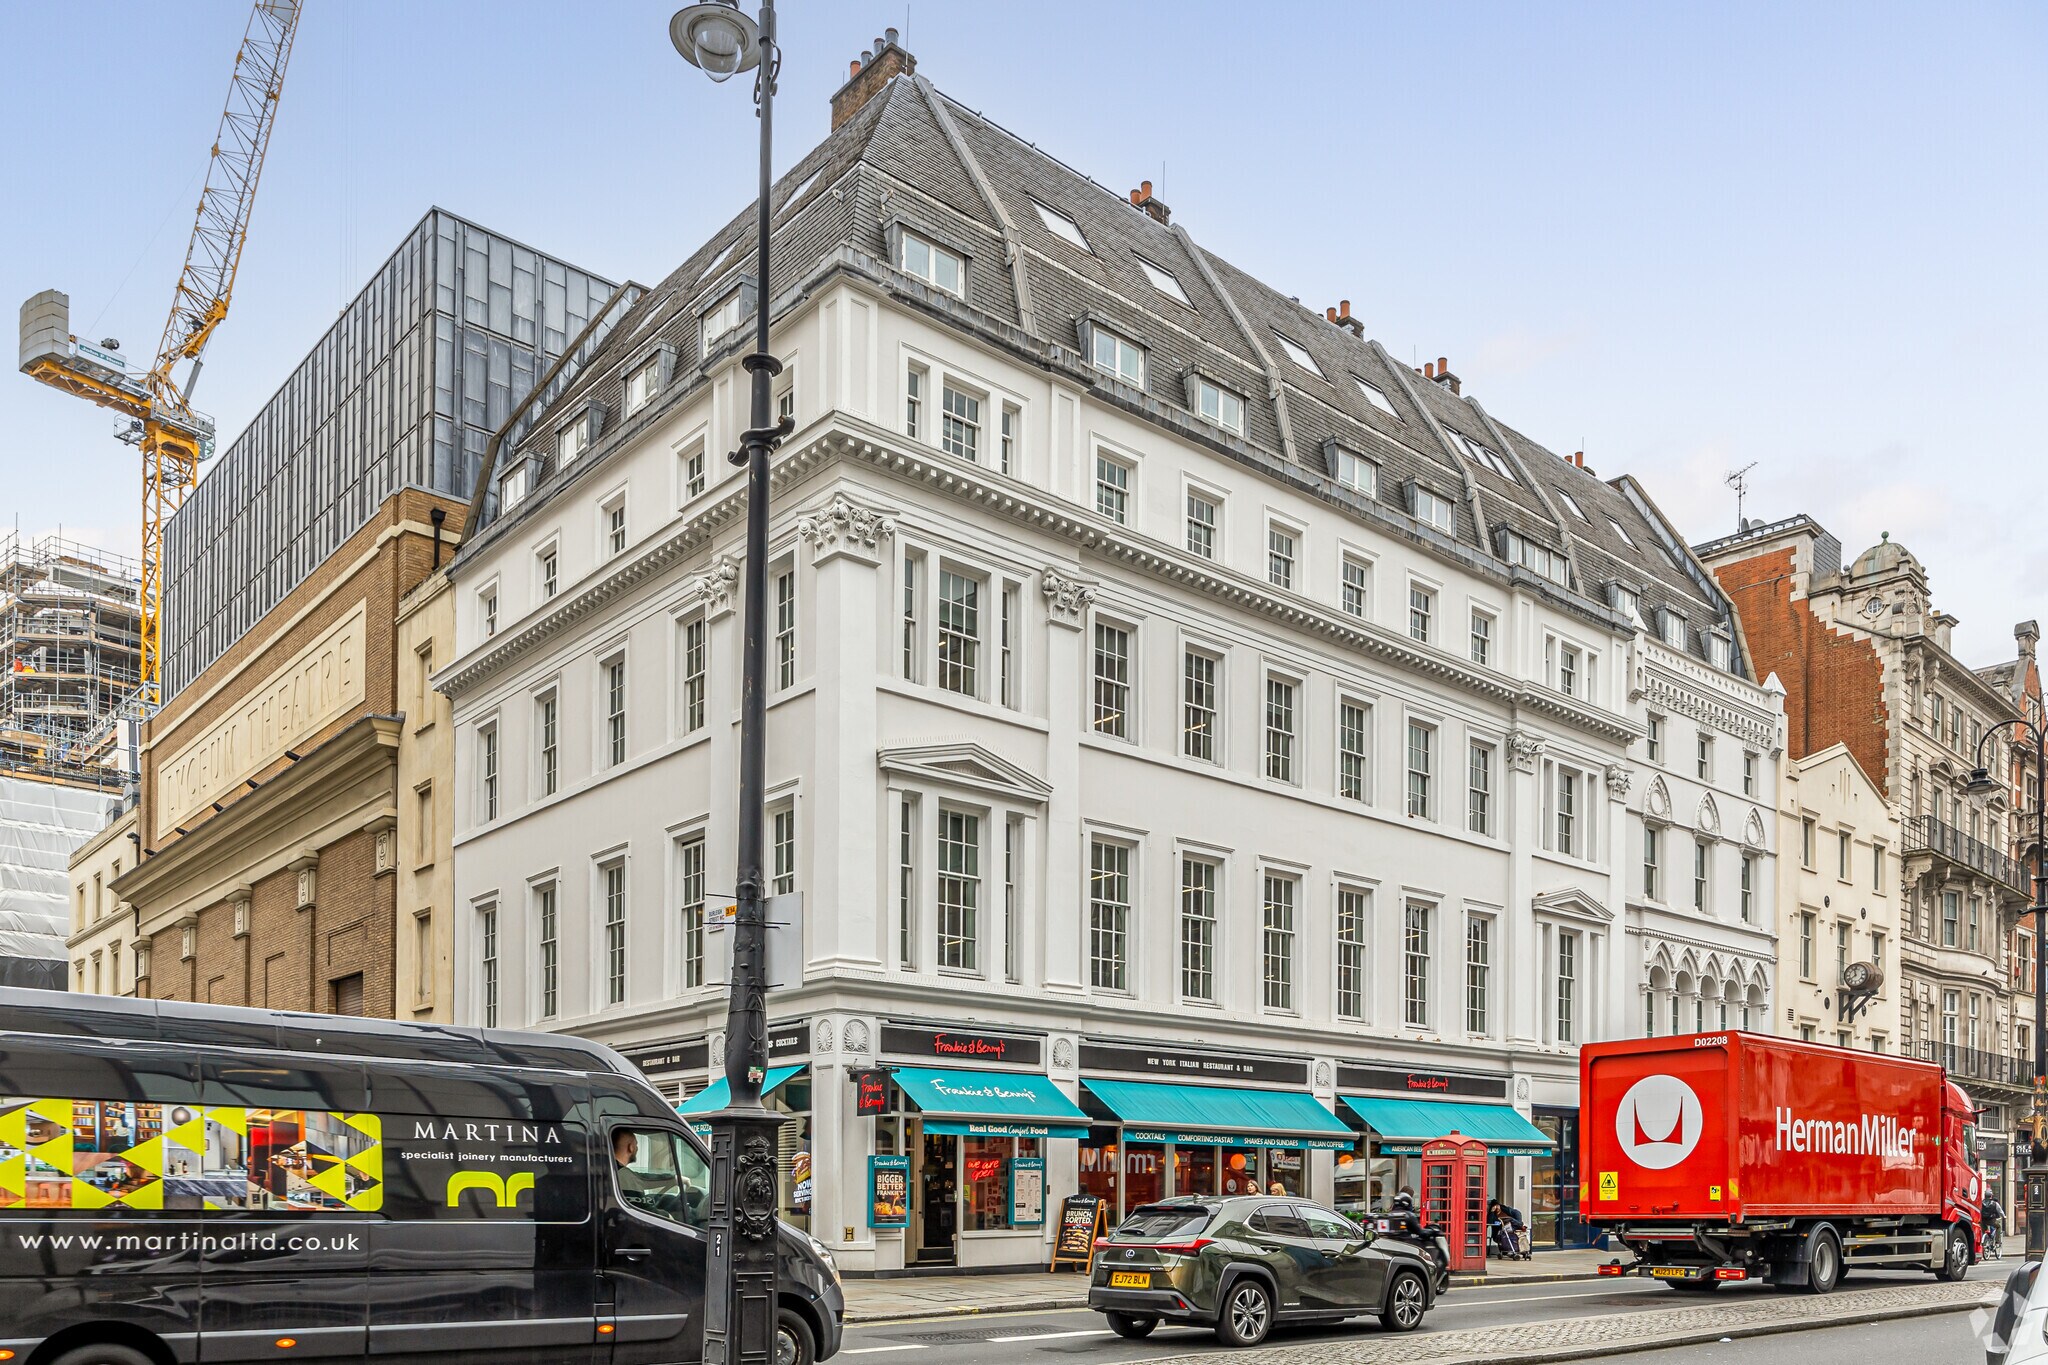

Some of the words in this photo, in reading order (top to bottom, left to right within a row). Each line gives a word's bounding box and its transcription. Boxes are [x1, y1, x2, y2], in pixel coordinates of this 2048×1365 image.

[168, 724, 236, 818] LYCEUM
[248, 635, 351, 759] THEATRE
[775, 1036, 798, 1047] COCKTAILS
[934, 1033, 968, 1054] Frankie
[976, 1039, 1006, 1060] Benny's
[1694, 1036, 1728, 1047] D02208
[642, 1057, 665, 1067] RESTAURANT
[672, 1055, 680, 1063] BAR
[1147, 1058, 1159, 1066] NEW
[1162, 1059, 1176, 1067] YORK
[1179, 1060, 1200, 1069] ITALIAN
[1203, 1062, 1234, 1071] RESTAURANT
[1243, 1065, 1253, 1073] BAR
[861, 1073, 883, 1094] Frankie
[1407, 1074, 1427, 1089] Frankie
[1432, 1077, 1449, 1092] Benny's
[930, 1078, 983, 1097] Frankie
[994, 1086, 1037, 1103] Benny's
[864, 1093, 885, 1112] Benny's
[413, 1121, 561, 1144] MARTINA
[969, 1124, 987, 1133] Real
[987, 1124, 1007, 1133] Good
[1008, 1125, 1029, 1136] Comfort
[1030, 1126, 1048, 1135] Food
[1775, 1106, 1917, 1157] HermanMiller
[1135, 1132, 1165, 1141] COCKTAILS
[1177, 1134, 1213, 1143] COMFORTING
[1213, 1135, 1234, 1144] PASTAS
[1244, 1137, 1263, 1145] SHAKES
[1264, 1138, 1276, 1146] AND
[1276, 1139, 1298, 1147] SUNDAES
[1976, 1140, 1987, 1150] TEEN
[401, 1151, 454, 1162] specialist
[457, 1152, 496, 1163] joinery
[500, 1153, 573, 1163] manufacturers
[874, 1157, 889, 1167] Frankie
[967, 1160, 981, 1169] we
[982, 1160, 999, 1169] are
[877, 1174, 904, 1183] BIGGER
[971, 1169, 995, 1181] open
[797, 1179, 812, 1191] NOW
[1064, 1216, 1092, 1224] SORTED.
[1066, 1210, 1094, 1218] BRUNCH,
[18, 1232, 361, 1251] www.martinaltd.co.uk
[1115, 1274, 1133, 1284] EJ72
[1133, 1275, 1148, 1285] BLN
